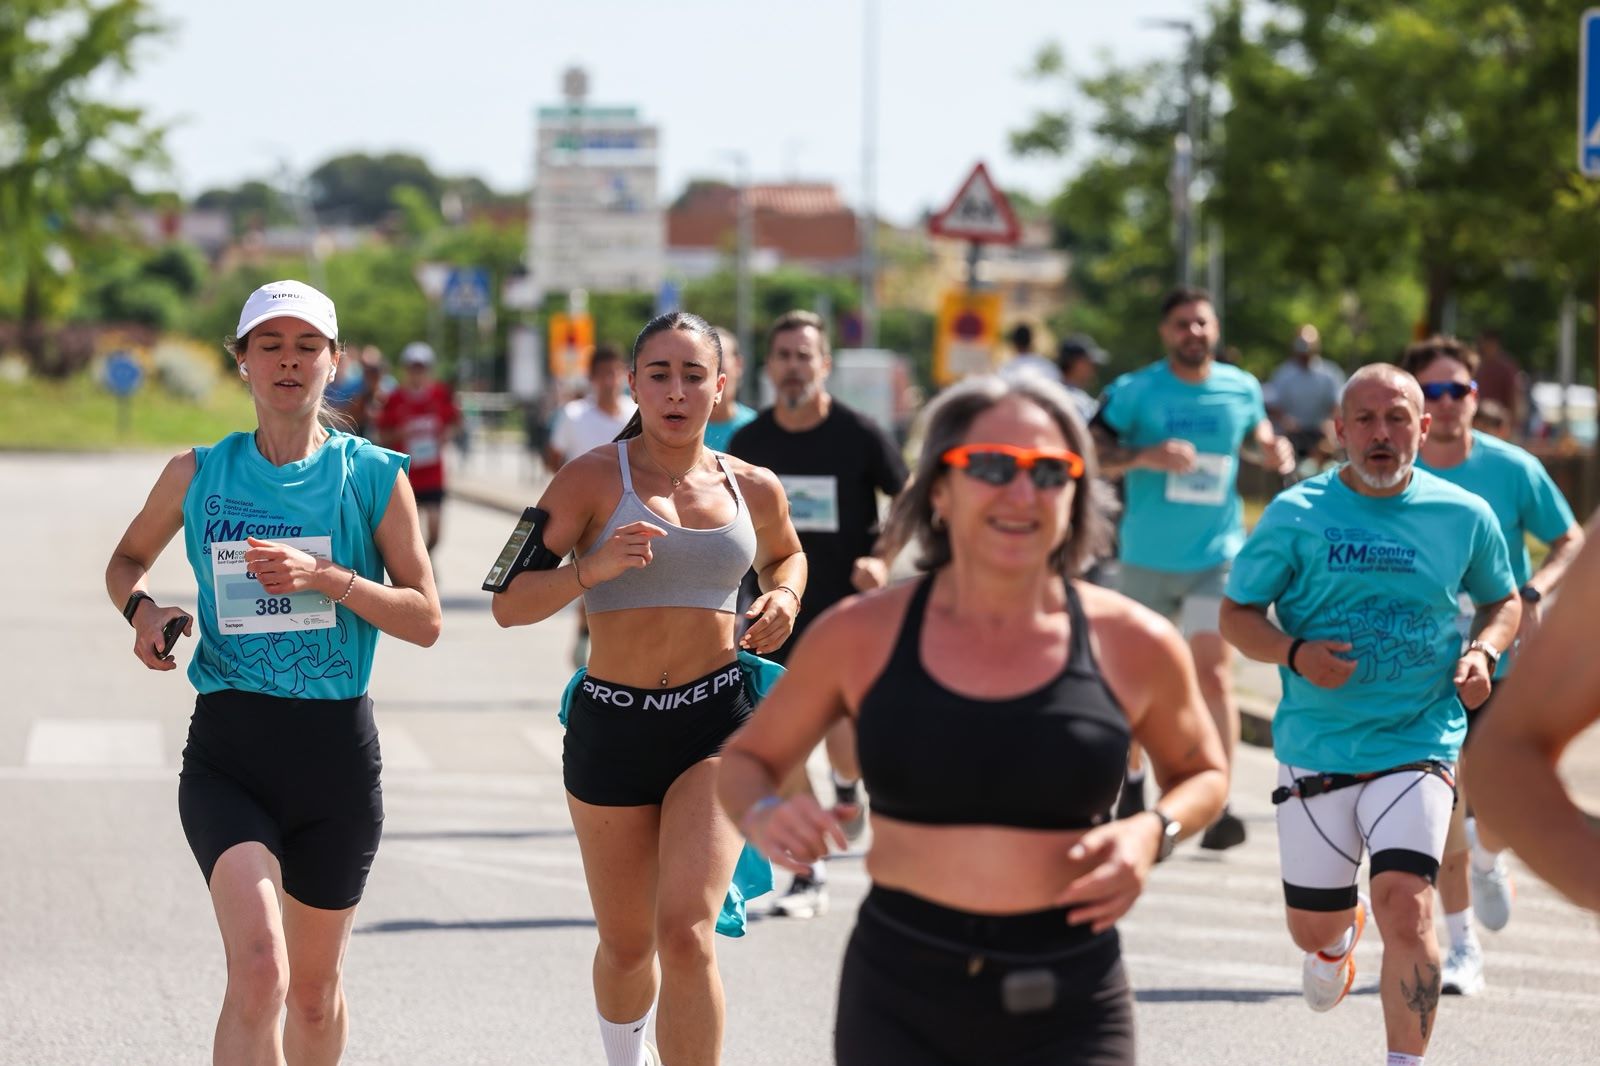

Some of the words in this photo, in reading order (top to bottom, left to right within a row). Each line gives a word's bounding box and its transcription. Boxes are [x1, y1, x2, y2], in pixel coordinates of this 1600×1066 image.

[204, 520, 245, 544] KM
[246, 523, 303, 537] contra
[218, 550, 235, 560] KM
[1328, 544, 1368, 564] KM
[1369, 546, 1416, 558] contra
[256, 597, 292, 616] 388
[583, 681, 634, 707] PRO
[643, 681, 709, 710] NIKE
[713, 666, 742, 694] PR
